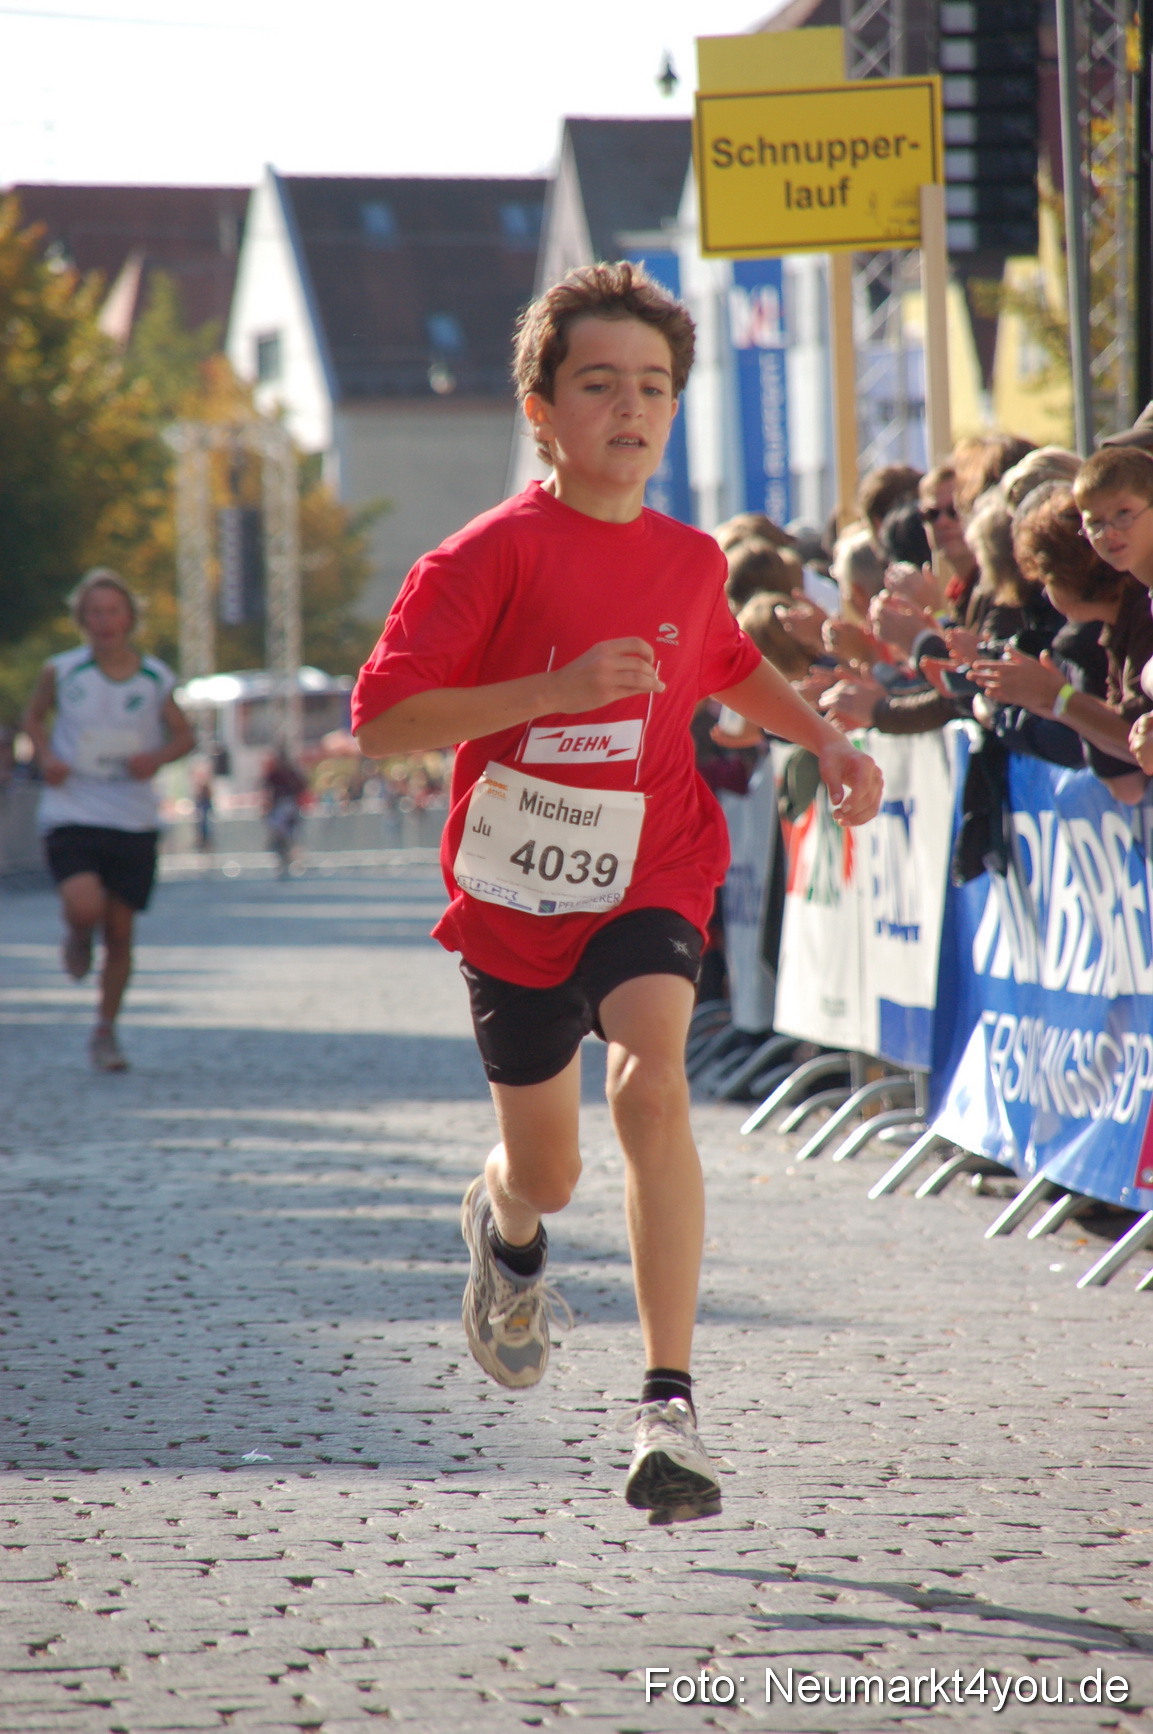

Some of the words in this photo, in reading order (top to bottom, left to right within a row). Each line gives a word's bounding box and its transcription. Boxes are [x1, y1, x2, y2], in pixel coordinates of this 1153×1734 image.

[711, 134, 920, 168] Schnupper-
[784, 176, 851, 209] lauf
[557, 735, 612, 753] DEHN
[518, 787, 603, 827] Michael
[472, 816, 492, 837] Ju
[509, 839, 619, 888] 4039
